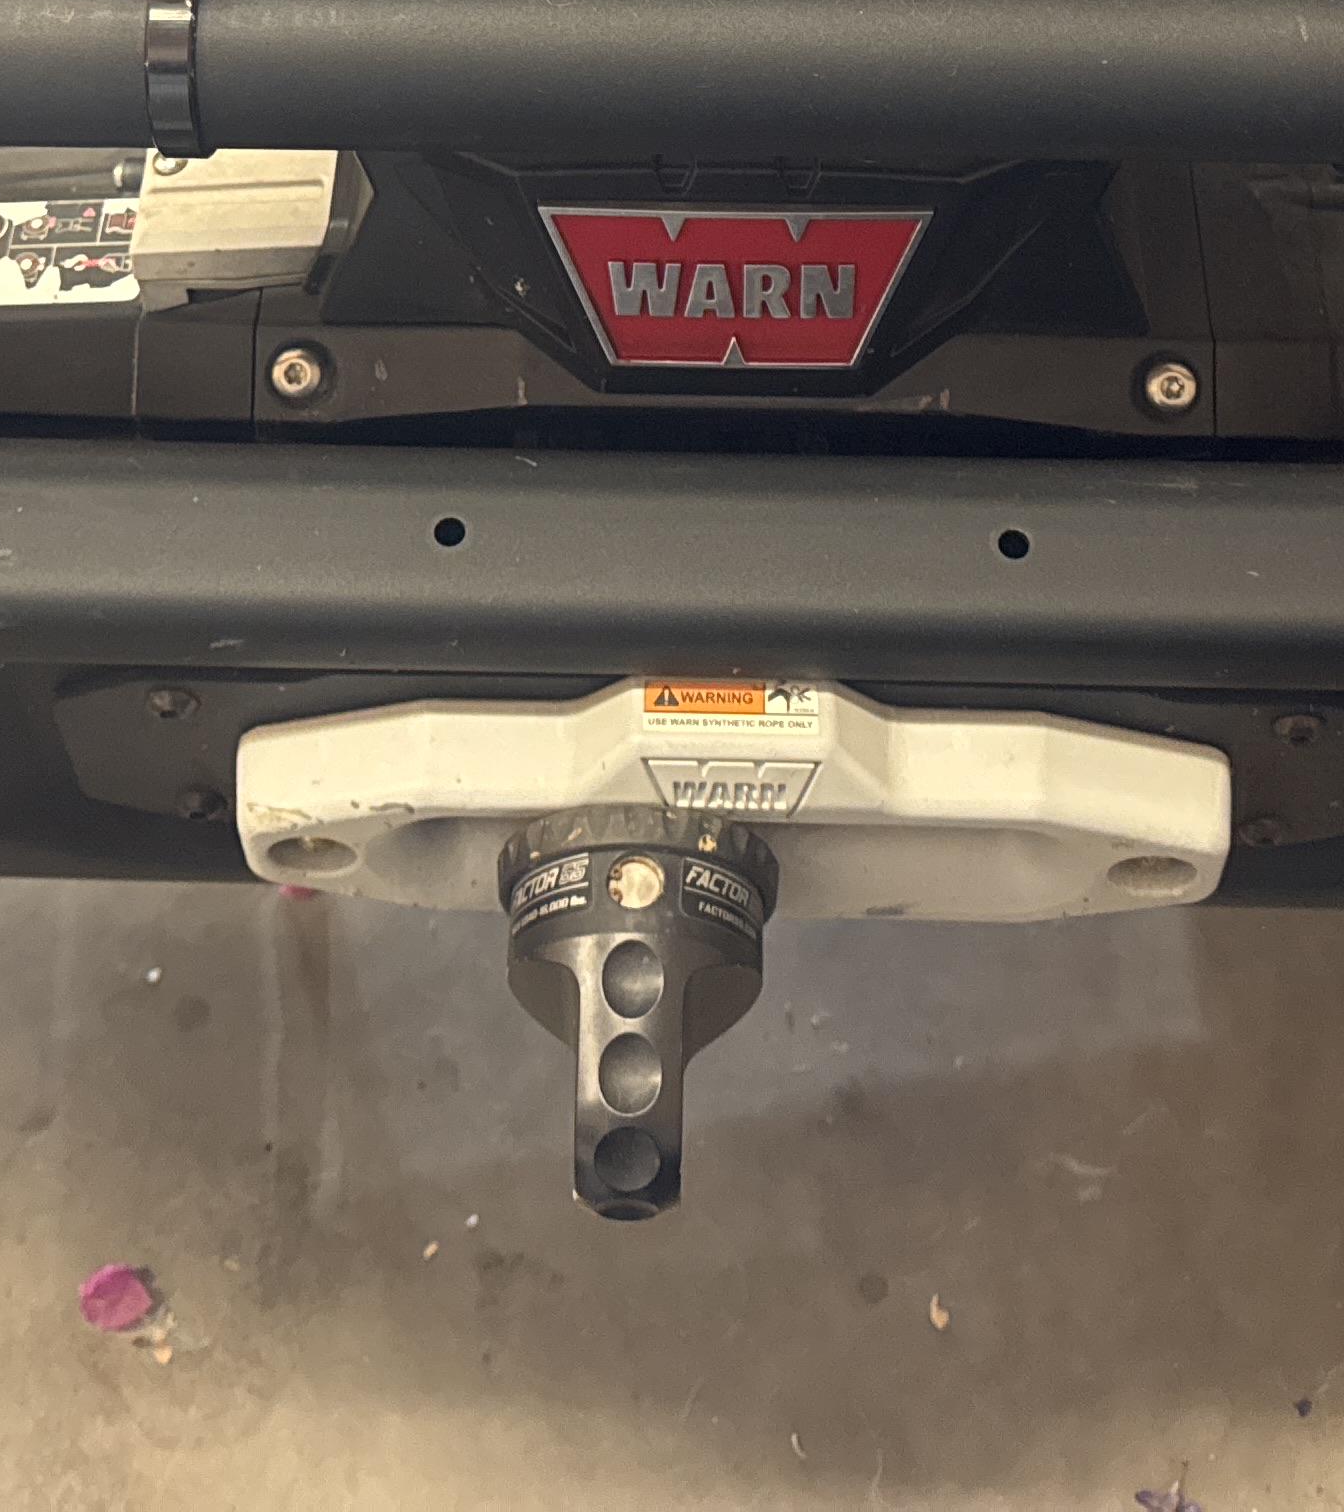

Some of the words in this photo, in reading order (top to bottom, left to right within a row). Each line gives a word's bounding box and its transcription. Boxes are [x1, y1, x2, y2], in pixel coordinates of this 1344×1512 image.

[607, 260, 856, 320] WARN
[680, 691, 754, 705] WARNING
[647, 717, 667, 726] USE
[670, 718, 700, 727] WARN
[702, 718, 756, 728] SYNTHETIC
[758, 720, 785, 729] ROPE
[787, 720, 813, 729] ONLY
[672, 781, 788, 809] WARN
[685, 865, 750, 908] FACTOR
